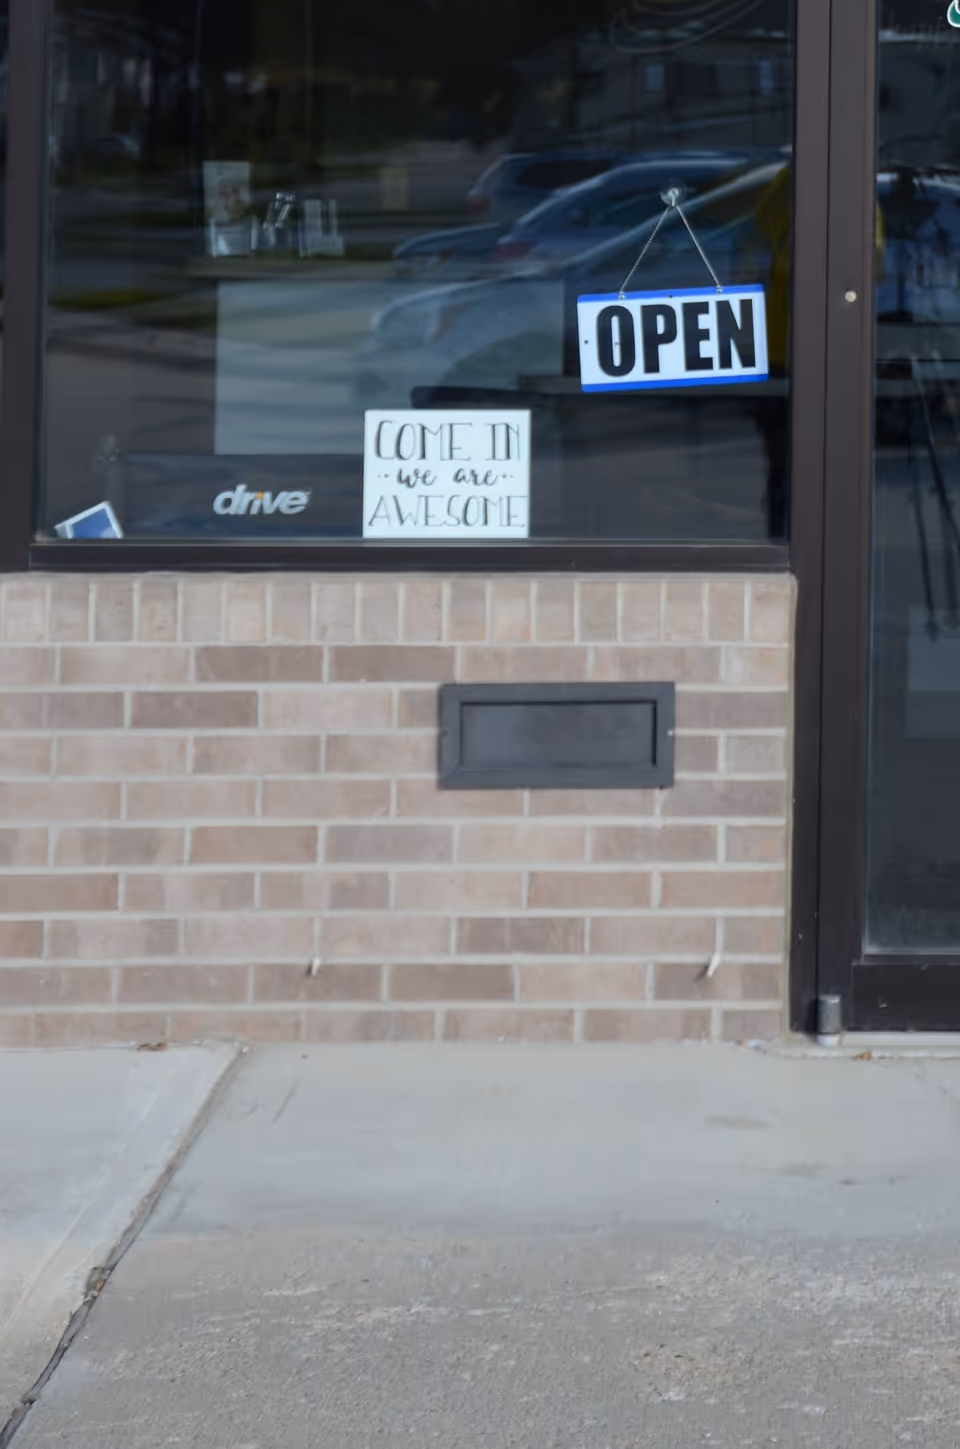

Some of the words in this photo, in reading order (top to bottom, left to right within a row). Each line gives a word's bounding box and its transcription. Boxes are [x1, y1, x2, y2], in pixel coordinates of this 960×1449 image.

[595, 297, 757, 378] OPEN
[374, 420, 473, 462] COME
[484, 421, 521, 462] IN
[396, 467, 438, 489] we
[452, 467, 498, 488] are
[212, 483, 309, 516] drive
[367, 493, 529, 528] AWESOME
